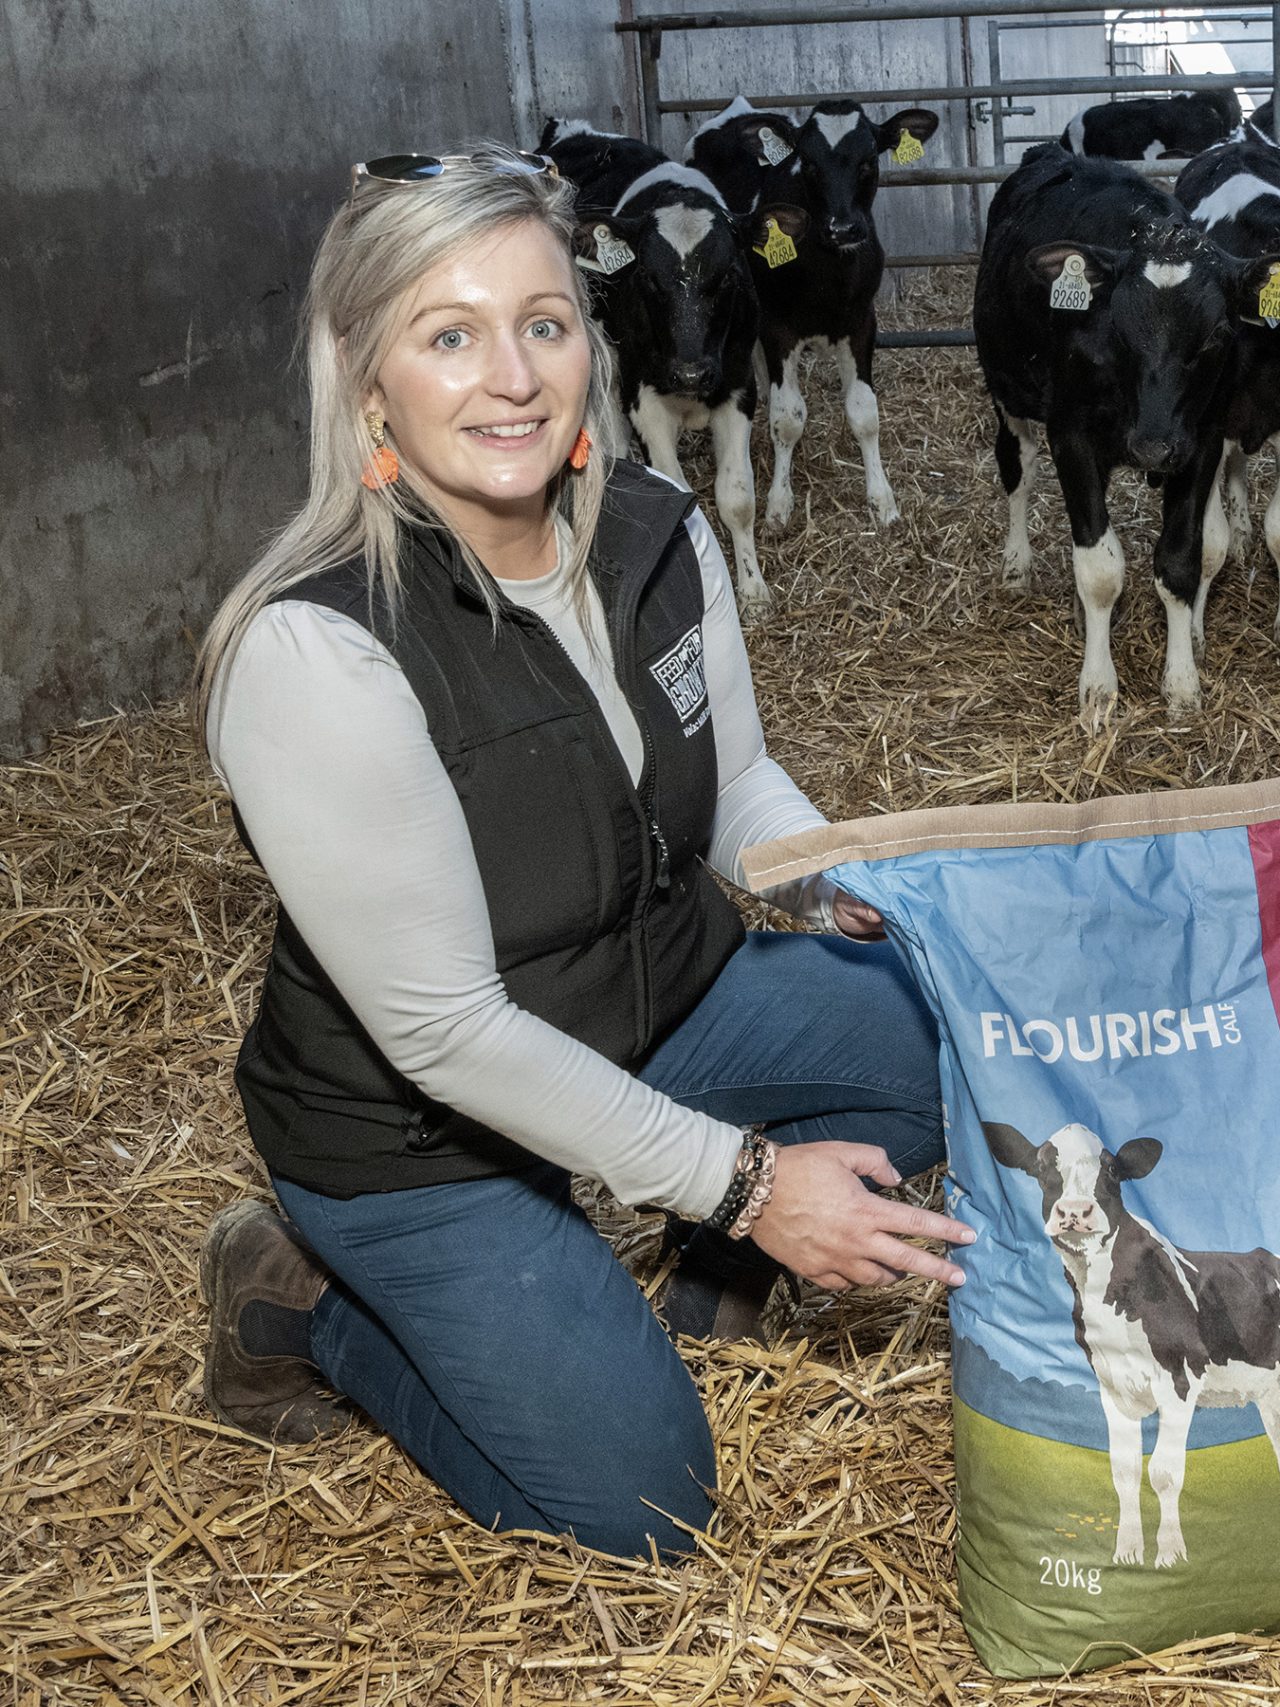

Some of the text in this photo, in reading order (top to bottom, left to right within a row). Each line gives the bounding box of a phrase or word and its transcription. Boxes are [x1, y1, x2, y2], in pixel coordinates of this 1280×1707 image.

[603, 245, 632, 272] 42684
[769, 244, 794, 266] 42684
[1053, 289, 1087, 308] 92689
[656, 632, 703, 687] FEED FOR
[669, 655, 706, 713] GROWT
[980, 1003, 1241, 1064] FLOURISH CALF
[1039, 1556, 1102, 1595] 20kg
